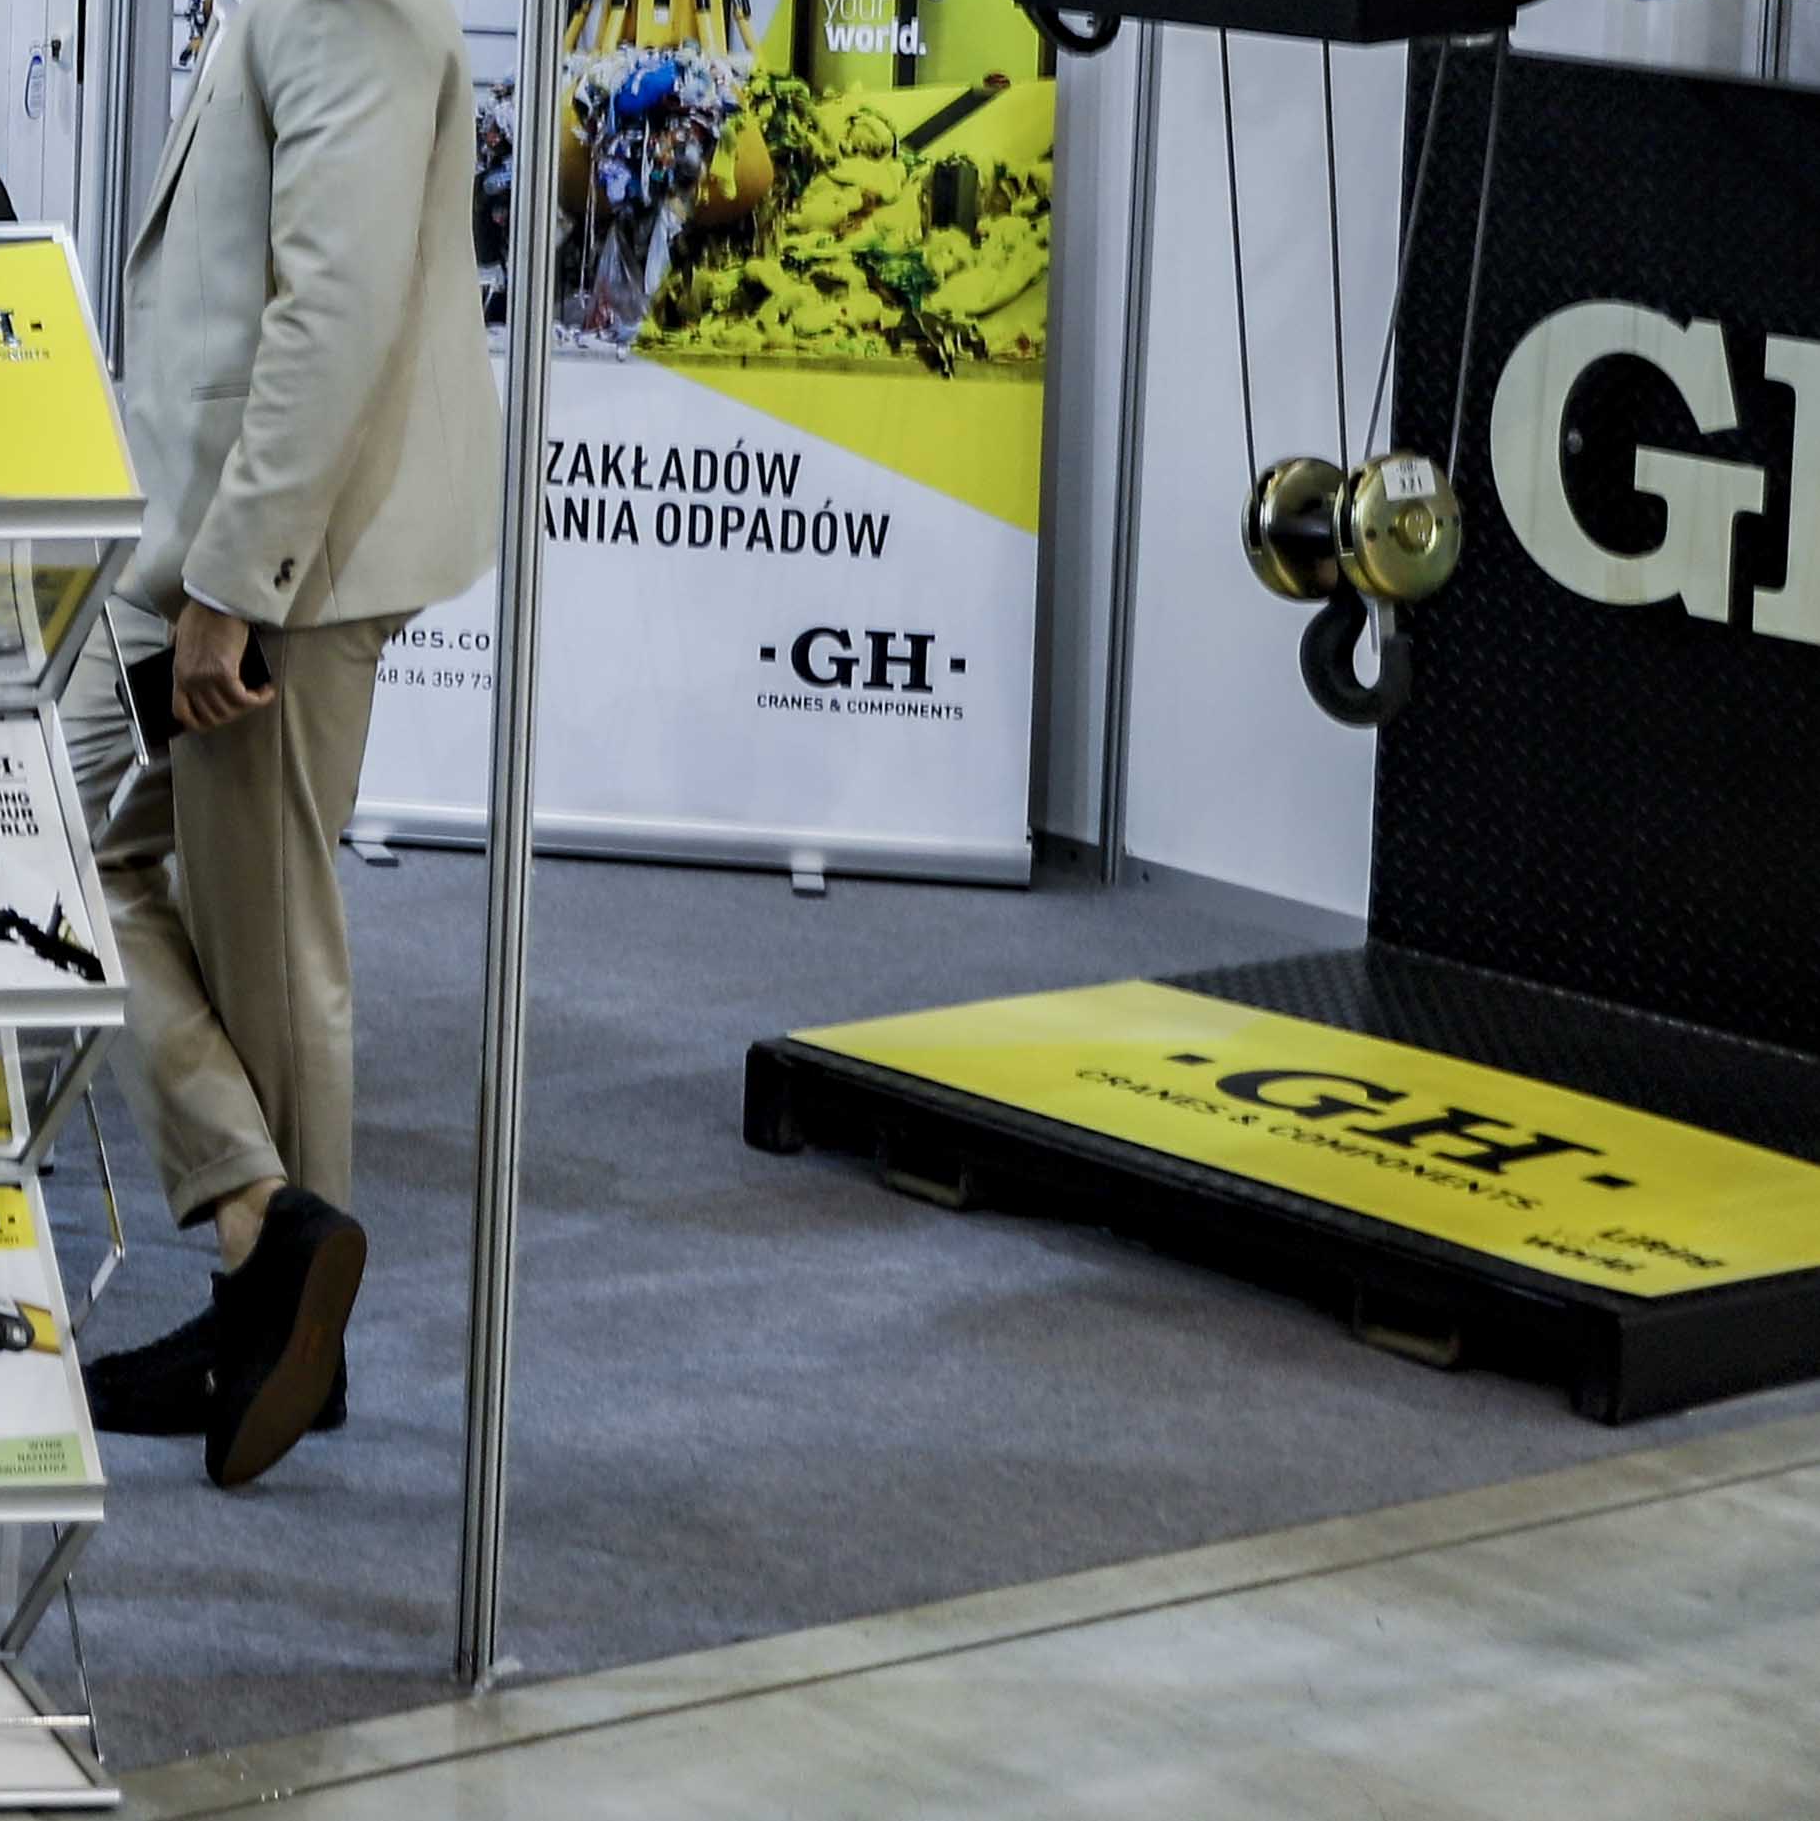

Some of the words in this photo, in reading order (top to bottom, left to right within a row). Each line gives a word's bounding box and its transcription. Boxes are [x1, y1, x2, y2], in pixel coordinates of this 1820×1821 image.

[825, 15, 928, 56] world.
[546, 438, 801, 498] ZAKŁADÓW
[656, 496, 890, 559] ODPADÓW
[405, 669, 425, 686] 34
[432, 671, 464, 689] 359
[790, 626, 936, 692] GH
[757, 694, 824, 714] CRANES
[830, 698, 841, 713] &
[846, 699, 964, 721] COMPONENTS
[1076, 1066, 1219, 1121] CRANES
[1266, 1122, 1542, 1213] COMPONENTS
[1216, 1070, 1602, 1177] GH
